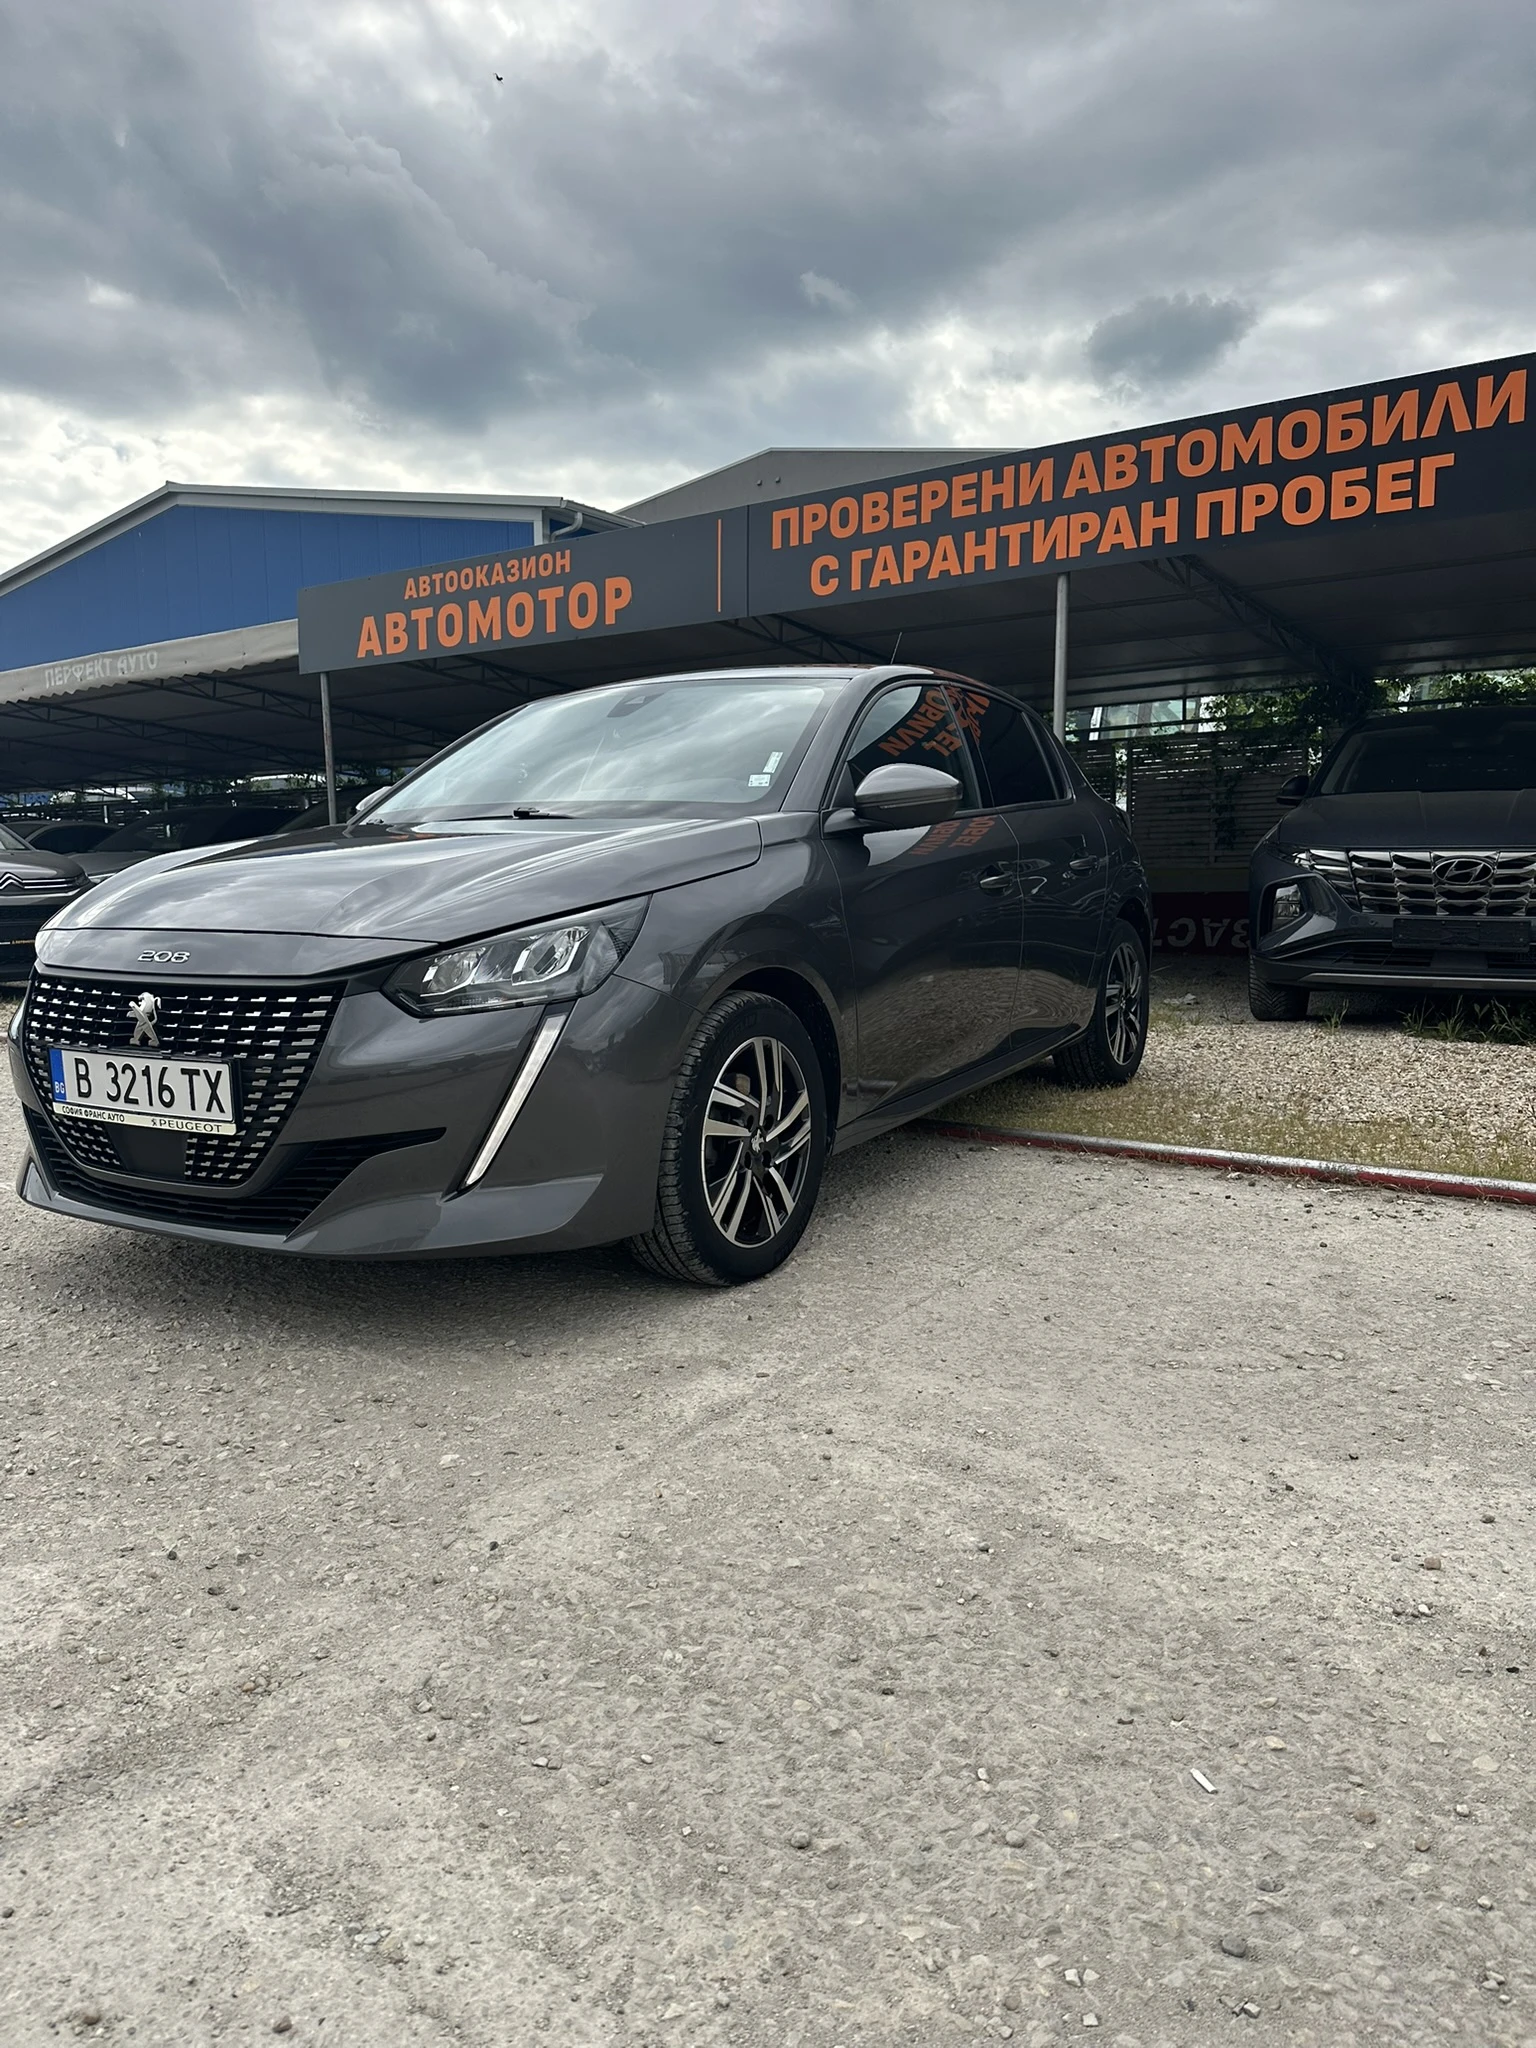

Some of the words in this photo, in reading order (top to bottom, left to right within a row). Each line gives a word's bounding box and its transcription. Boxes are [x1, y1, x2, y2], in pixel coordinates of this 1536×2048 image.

[772, 458, 1055, 550] ПРОВЕРЕНИ
[1063, 369, 1528, 499] АВТОМОБИЛИ
[810, 555, 839, 596] С
[850, 497, 1180, 591] ГАРАНТИРАН
[1195, 453, 1456, 540] ПРОБЕГ
[404, 549, 572, 600] АВТООКАЗИОН
[356, 576, 633, 659] АВТОМОТОР
[44, 658, 113, 689] ПЕРФЕКТ
[116, 650, 159, 677] АУТО
[137, 949, 191, 963] 208
[55, 1081, 65, 1094] BG
[74, 1057, 92, 1098] B
[106, 1061, 175, 1108] 3216
[181, 1068, 226, 1113] TX
[62, 1105, 83, 1116] СОФИЯ
[84, 1110, 106, 1120] ФРАНС
[107, 1113, 125, 1123] АУТО
[159, 1119, 222, 1133] PEUGEOT
